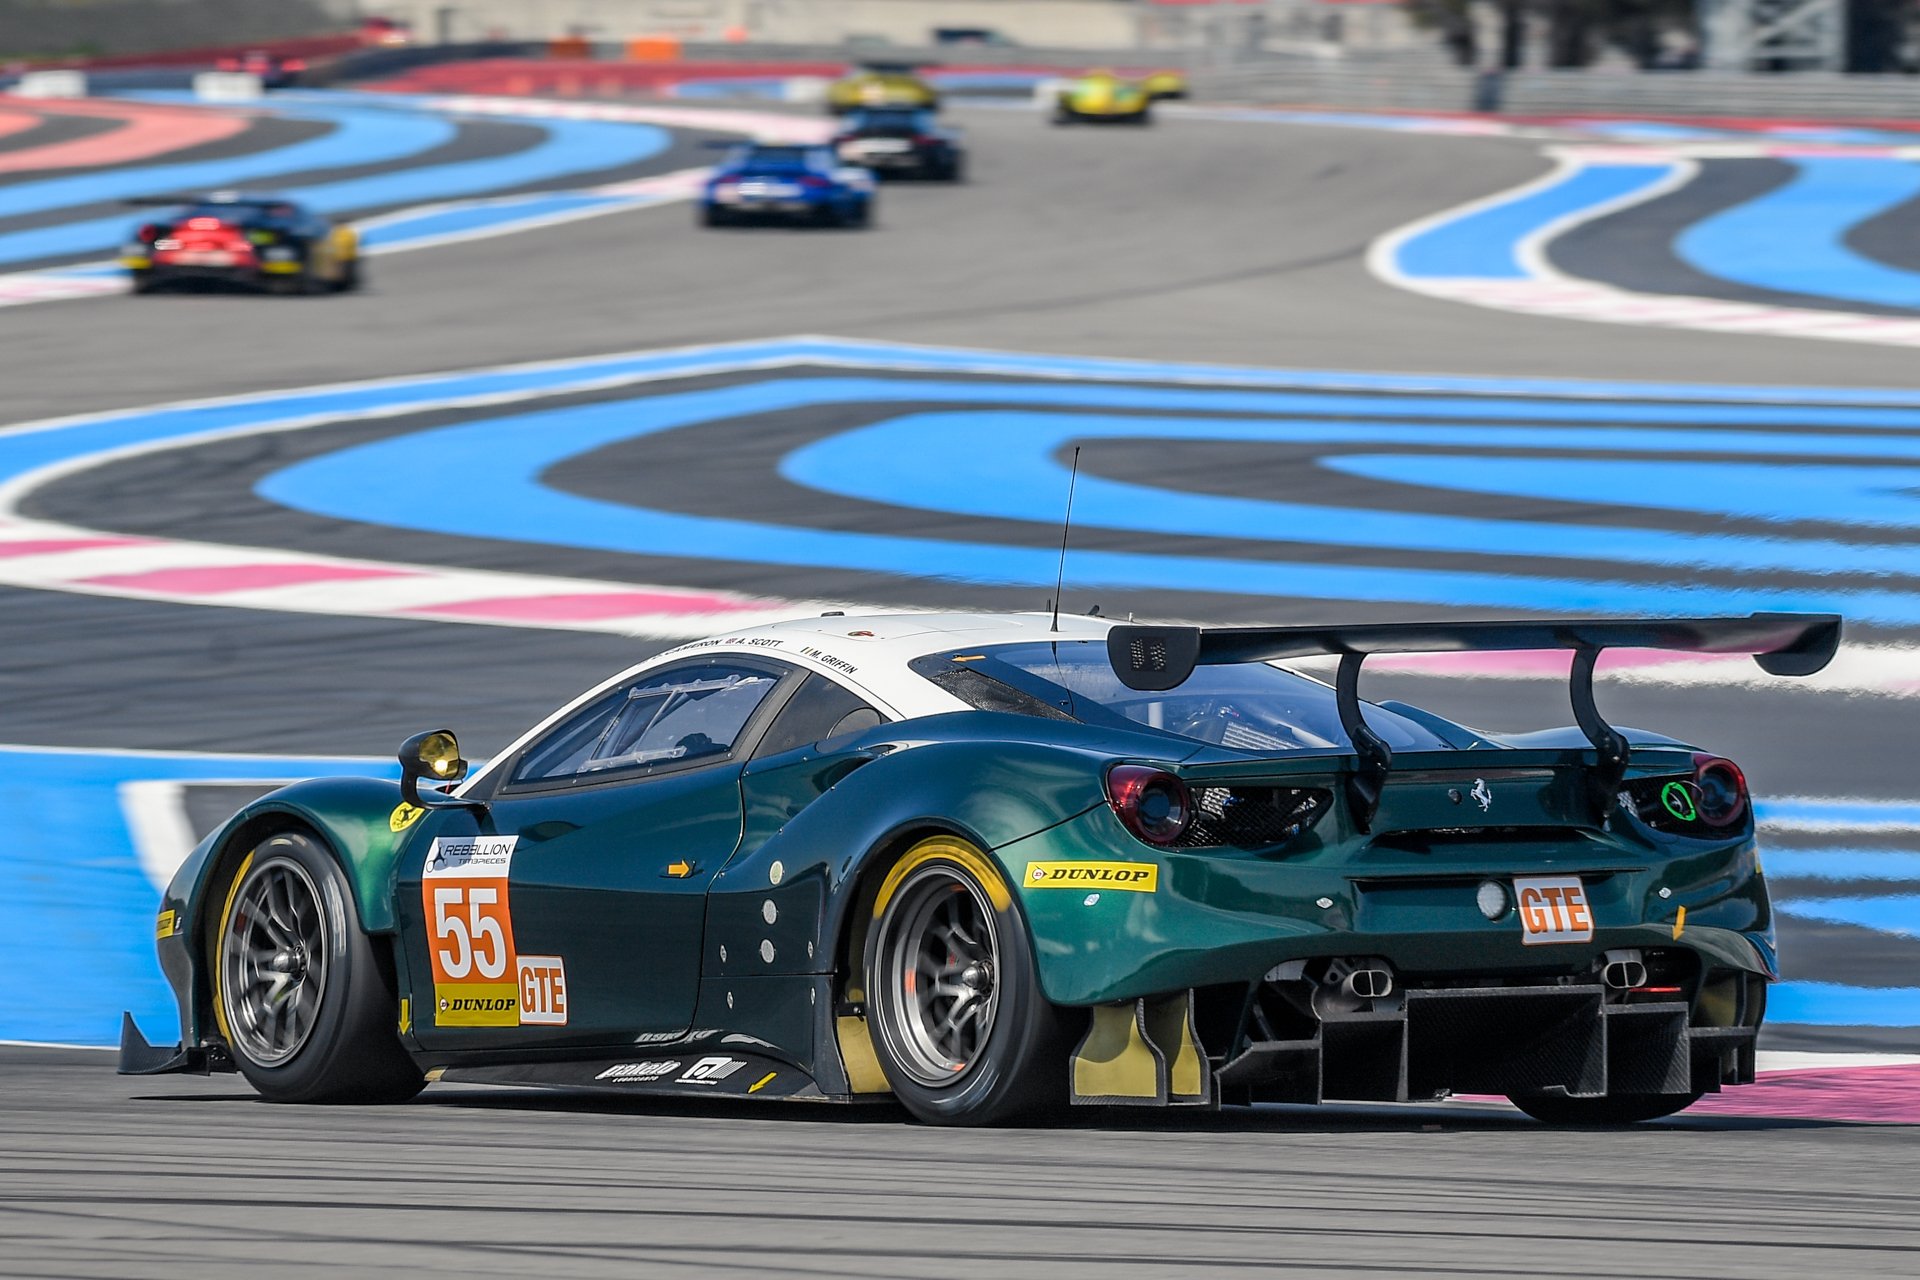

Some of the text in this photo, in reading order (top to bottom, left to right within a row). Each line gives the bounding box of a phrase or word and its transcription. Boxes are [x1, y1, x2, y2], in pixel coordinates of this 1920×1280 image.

[748, 637, 784, 648] SCOTT
[821, 654, 858, 675] GRIFFIN
[444, 843, 511, 856] REBELLION
[1048, 868, 1150, 883] DUNLOP
[1521, 887, 1589, 933] GTE
[435, 888, 506, 979] 55
[520, 966, 563, 1013] GTE
[451, 999, 515, 1011] DUNLOP
